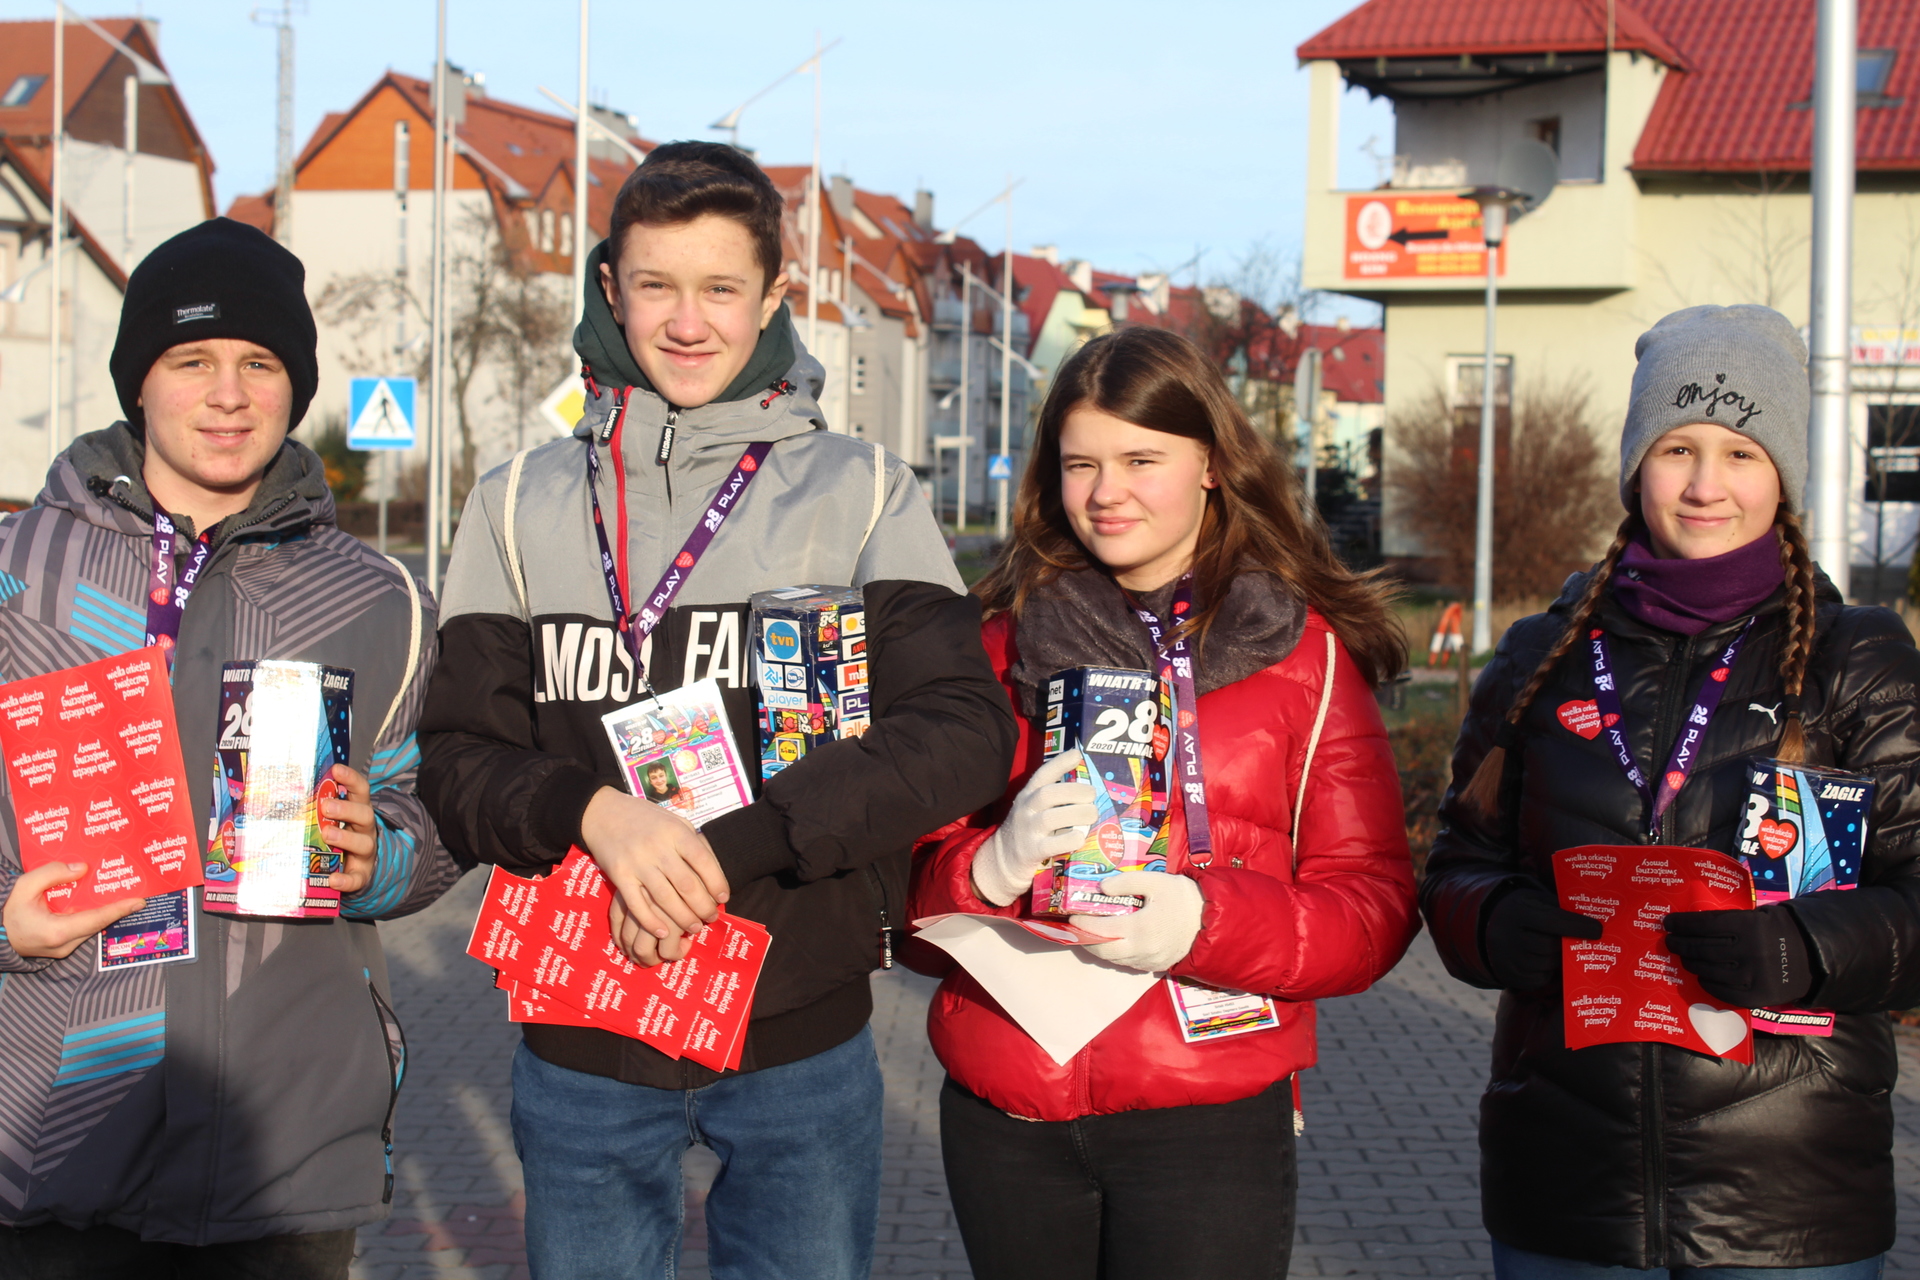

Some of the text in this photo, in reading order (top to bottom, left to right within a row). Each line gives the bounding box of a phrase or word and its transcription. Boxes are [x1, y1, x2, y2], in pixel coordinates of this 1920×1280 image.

[1671, 375, 1762, 428] enjoy
[704, 472, 745, 532] 28 PLAY
[156, 512, 174, 584] 28 PLAY
[184, 544, 208, 584] PLAY
[609, 574, 622, 612] PLAY
[639, 569, 680, 634] 28 PLAY
[770, 632, 794, 646] tvn
[106, 660, 151, 680] wielka orkiestra
[1172, 657, 1188, 678] 28
[1593, 640, 1611, 691] 28 PLAY
[223, 669, 251, 682] WIATR
[324, 672, 350, 690] ŻAGLE
[1088, 674, 1158, 692] WIATR W
[122, 685, 145, 701] pomocy
[1049, 685, 1062, 696] net
[0, 690, 44, 710] wielka orkiestra
[768, 694, 803, 706] player
[1561, 706, 1582, 717] wielka
[16, 715, 39, 730] pomocy
[118, 718, 163, 738] wielka orkiestra
[800, 714, 812, 734] 28
[1086, 700, 1158, 752] 28
[1576, 720, 1601, 732] pomocy
[1676, 706, 1708, 769] 28 PLAY
[134, 743, 157, 759] pomocy
[1090, 742, 1154, 758] 2020 FINAŁ
[1610, 730, 1630, 766] PLAY
[12, 748, 57, 768] wielka orkiestra
[1185, 732, 1200, 804] 28 PLAY
[28, 773, 51, 788] pomocy
[130, 776, 175, 796] wielka orkiestra
[1820, 782, 1865, 802] ŻAGLE
[25, 806, 70, 825] wielka orkiestra
[146, 801, 169, 817] pomocy
[41, 830, 64, 846] pomocy
[142, 834, 187, 854] wielka orkiestra
[1565, 854, 1617, 863] wielka orkiestra
[1642, 858, 1669, 867] pomocy
[159, 859, 182, 875] pomocy
[1580, 870, 1606, 880] pomocy
[1694, 861, 1744, 880] wielka orkiestra
[1631, 876, 1684, 886] wielka orkiestra
[1709, 880, 1734, 893] pomocy
[47, 887, 72, 902] pomocy
[1568, 894, 1619, 905] wielka orkiestra
[305, 898, 338, 908] ZABIEGOWEJ
[1644, 902, 1670, 913] pomocy
[110, 943, 131, 951] RICOH
[1570, 940, 1621, 953] wielka orkiestra
[1644, 951, 1670, 963] pomocy
[1779, 937, 1789, 984] FORCLAZ
[1584, 963, 1610, 973] pomocy
[1634, 970, 1684, 986] wielka orkiestra
[1571, 995, 1621, 1007] wielka orkiestra
[1644, 1001, 1670, 1013] pomocy
[1584, 1017, 1611, 1028] pomocy
[1634, 1020, 1684, 1035] wielka orkiestra
[1778, 1014, 1831, 1026] ZABIEGOWEJ
